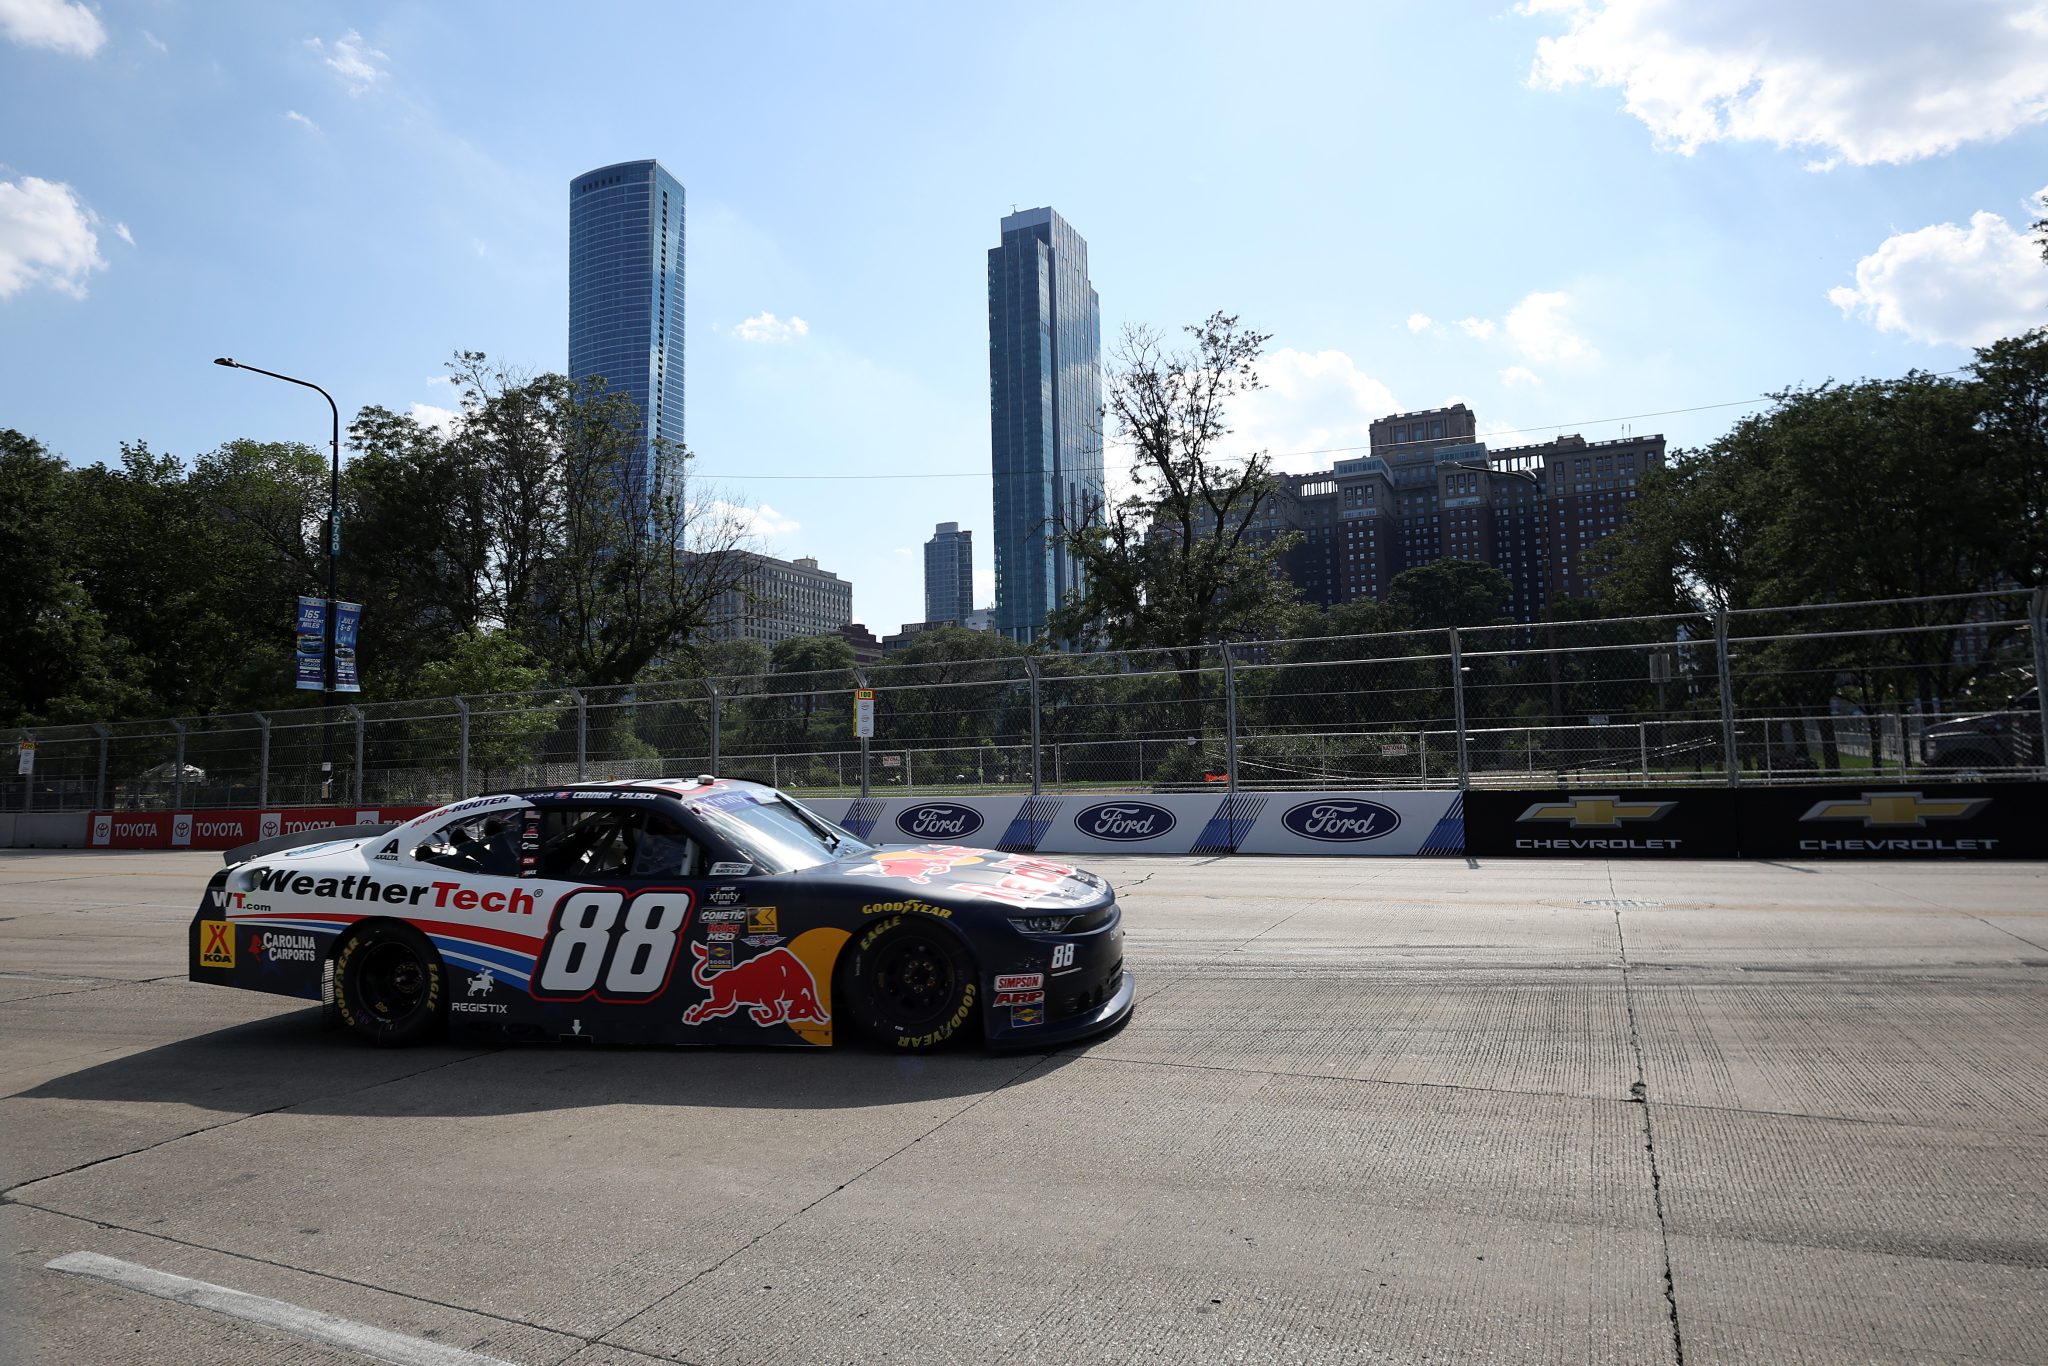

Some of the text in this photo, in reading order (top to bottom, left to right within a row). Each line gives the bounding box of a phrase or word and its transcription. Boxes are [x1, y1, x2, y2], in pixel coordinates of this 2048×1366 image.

[332, 515, 341, 551] C730
[304, 610, 321, 619] 165
[903, 623, 925, 633] EBONY
[571, 791, 657, 800] CONNOR ZILISCH
[913, 807, 964, 834] Ford
[1094, 807, 1155, 834] Ford
[1305, 805, 1376, 834] Ford
[114, 823, 158, 837] TOYOTA
[195, 822, 243, 837] TOYOTA
[1515, 839, 1682, 849] CHEVROLET
[1799, 839, 1999, 850] CHEVROLET
[212, 890, 271, 912] WT.com
[709, 890, 740, 903] xfinity
[701, 909, 746, 920] COMETIC
[862, 900, 952, 919] GOODYEAR
[262, 932, 316, 950] CAROLINA
[707, 933, 736, 941] MSD
[860, 916, 901, 951] EAGLE
[541, 892, 690, 993] 88
[203, 953, 232, 964] KOA
[268, 947, 316, 962] CARPORTS
[1051, 943, 1075, 969] 88
[335, 937, 359, 1027] GOODYEAR
[427, 963, 440, 1011] EAGLE
[998, 975, 1040, 989] SIMPSON
[995, 991, 1043, 1005] ARP
[451, 1002, 508, 1014] REGISTIX
[897, 984, 976, 1048] GOODYEAR
